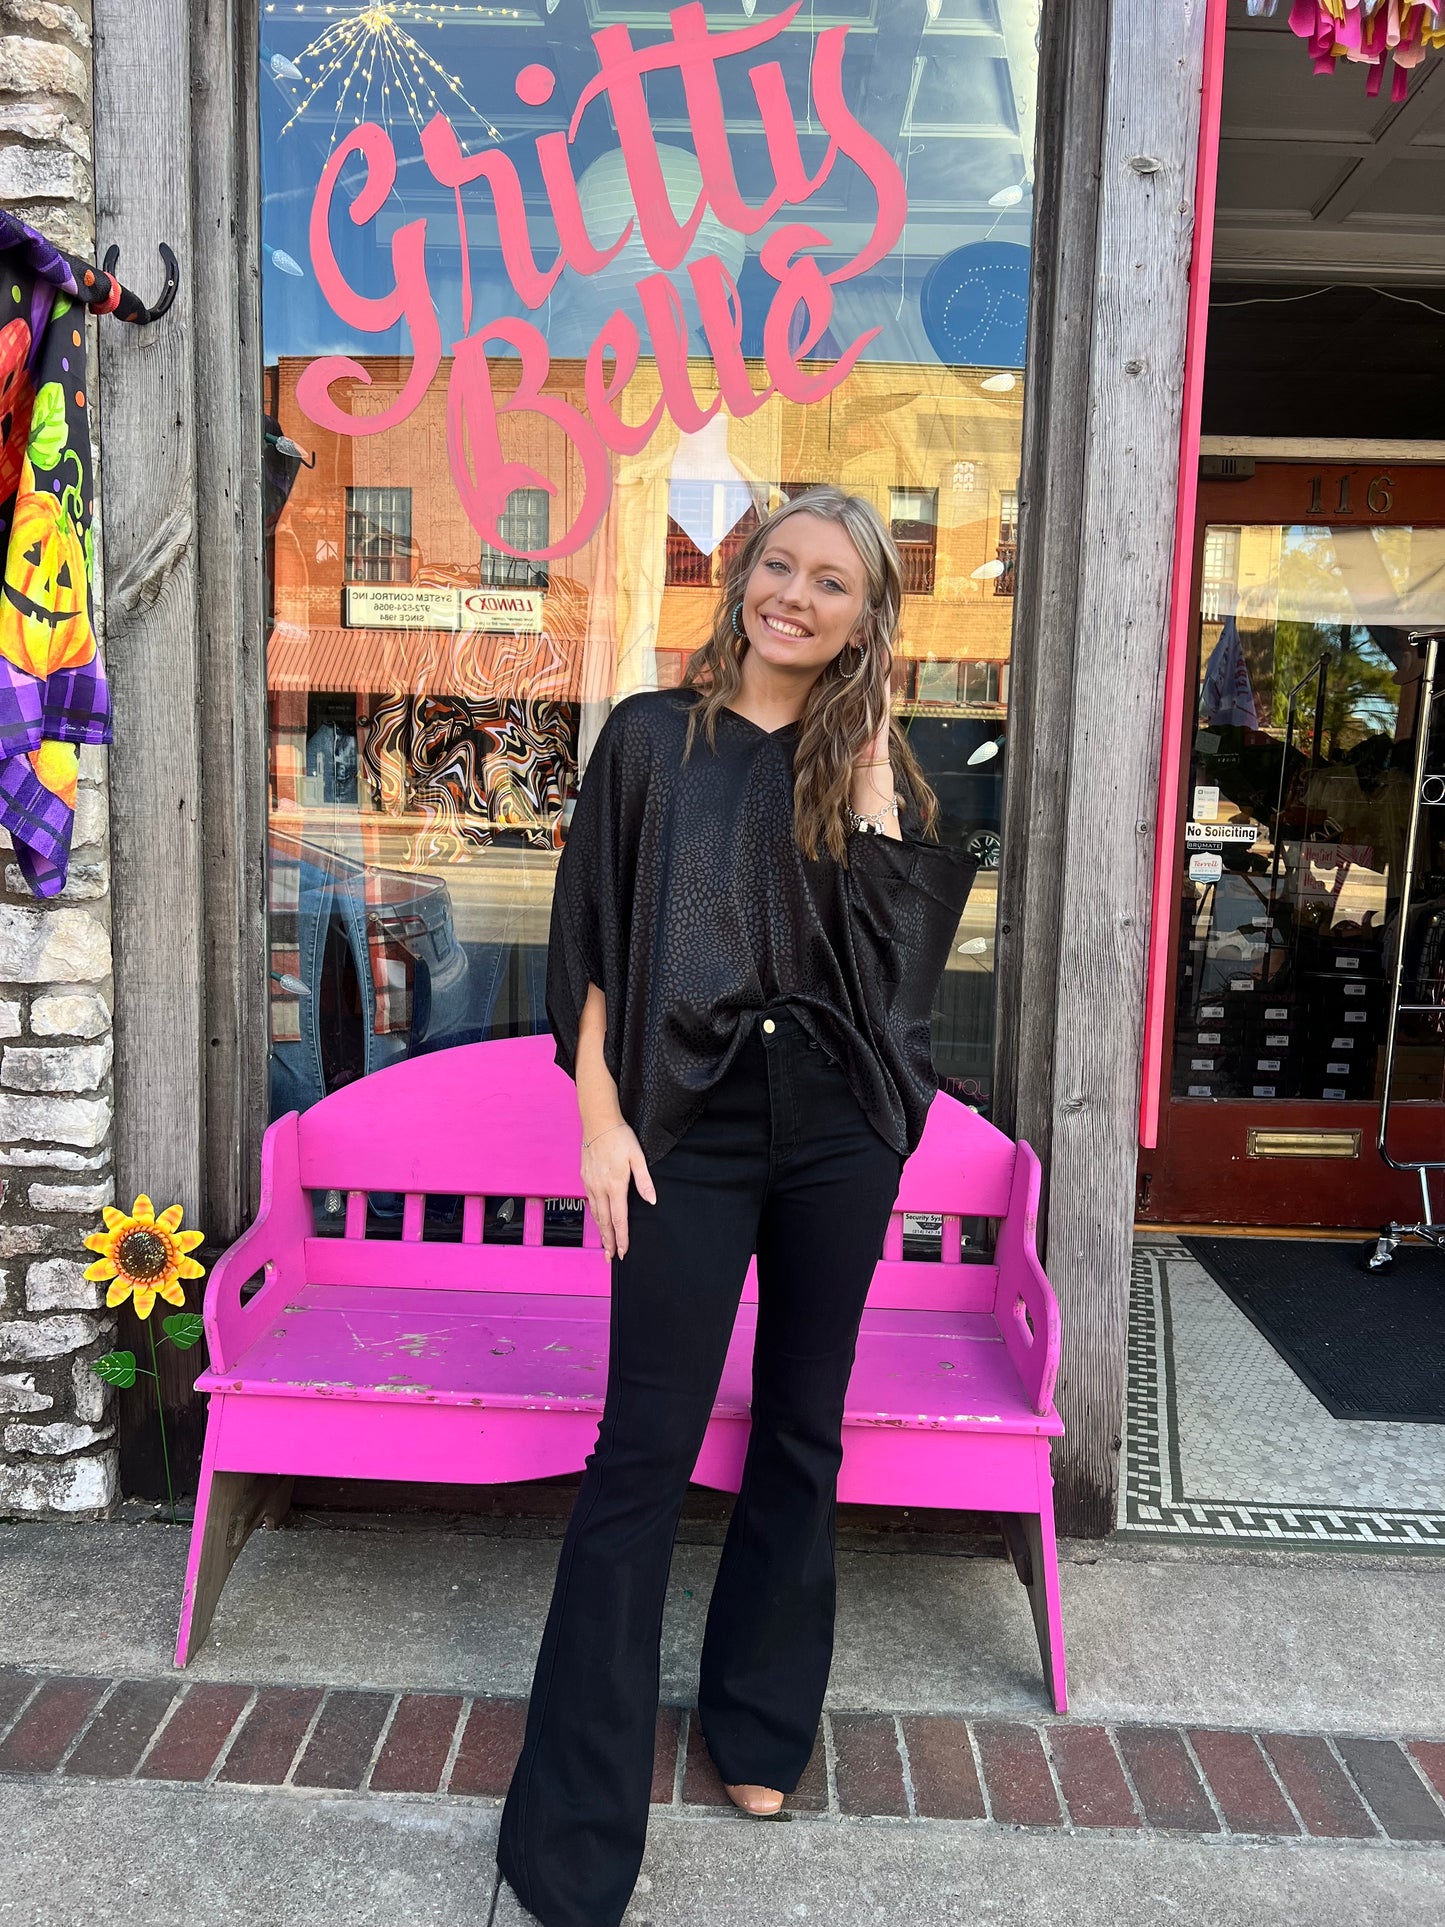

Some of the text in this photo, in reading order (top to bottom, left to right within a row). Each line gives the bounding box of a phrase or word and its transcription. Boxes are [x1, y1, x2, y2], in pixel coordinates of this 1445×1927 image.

[296, 1, 908, 436] Gritty
[446, 224, 884, 561] Belle
[1306, 475, 1396, 514] 116
[1187, 825, 1256, 840] No Soliciting
